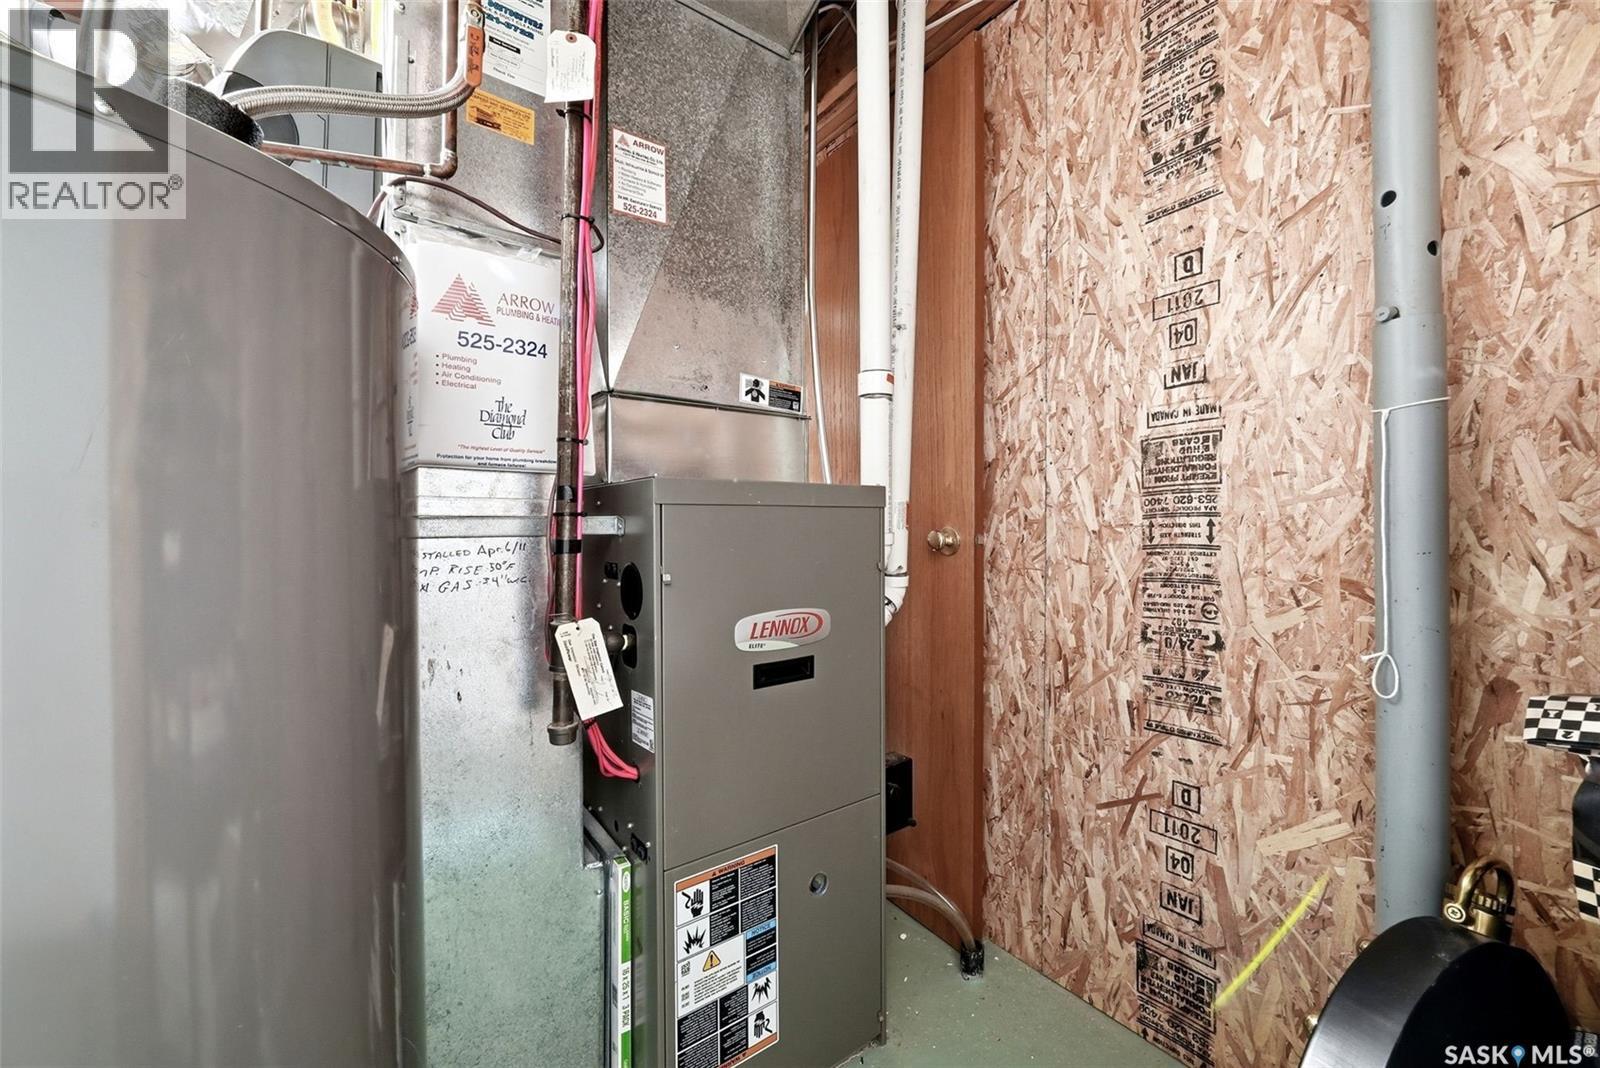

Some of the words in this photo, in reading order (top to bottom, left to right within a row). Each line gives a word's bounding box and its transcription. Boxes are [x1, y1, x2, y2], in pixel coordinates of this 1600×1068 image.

[632, 138, 663, 156] ARROW
[623, 201, 656, 218] 525-2324
[1183, 255, 1194, 273] D
[498, 293, 555, 315] ARROW
[1166, 288, 1204, 314] 2011
[496, 306, 534, 321] PLUMBING
[536, 314, 540, 322] &
[1174, 324, 1194, 344] 04
[457, 330, 548, 358] 525-2324
[442, 353, 478, 365] Plumbing
[442, 362, 471, 373] Heating
[1170, 360, 1198, 384] JAN
[442, 371, 452, 379] Air
[454, 372, 502, 385] Conditioning
[442, 380, 476, 390] Electrical
[495, 396, 512, 414] The
[1196, 406, 1217, 416] MADE
[480, 409, 527, 426] Diamond
[1151, 410, 1179, 422] CANADA
[1182, 410, 1192, 418] IN
[491, 425, 515, 440] Club
[1171, 435, 1200, 447] CARB
[436, 453, 464, 461] Protection
[1178, 444, 1200, 455] HUD
[1155, 451, 1216, 467] REGULATIONS
[1145, 461, 1216, 476] FORMALDEHYDE
[1182, 470, 1216, 482] EXEMPT
[1154, 473, 1178, 483] FROM
[448, 564, 483, 576] RISE
[438, 580, 472, 594] GAS
[750, 616, 810, 640] LENNOX
[1164, 635, 1194, 651] 24/0
[1181, 788, 1192, 806] D
[1164, 816, 1200, 844] 2011
[718, 860, 746, 874] WARNING
[1170, 852, 1191, 874] 04
[1166, 888, 1194, 914] JAN
[752, 922, 770, 936] NOTICE
[1178, 938, 1188, 948] IN
[1189, 942, 1212, 962] MADE
[752, 965, 772, 978] NOTICE
